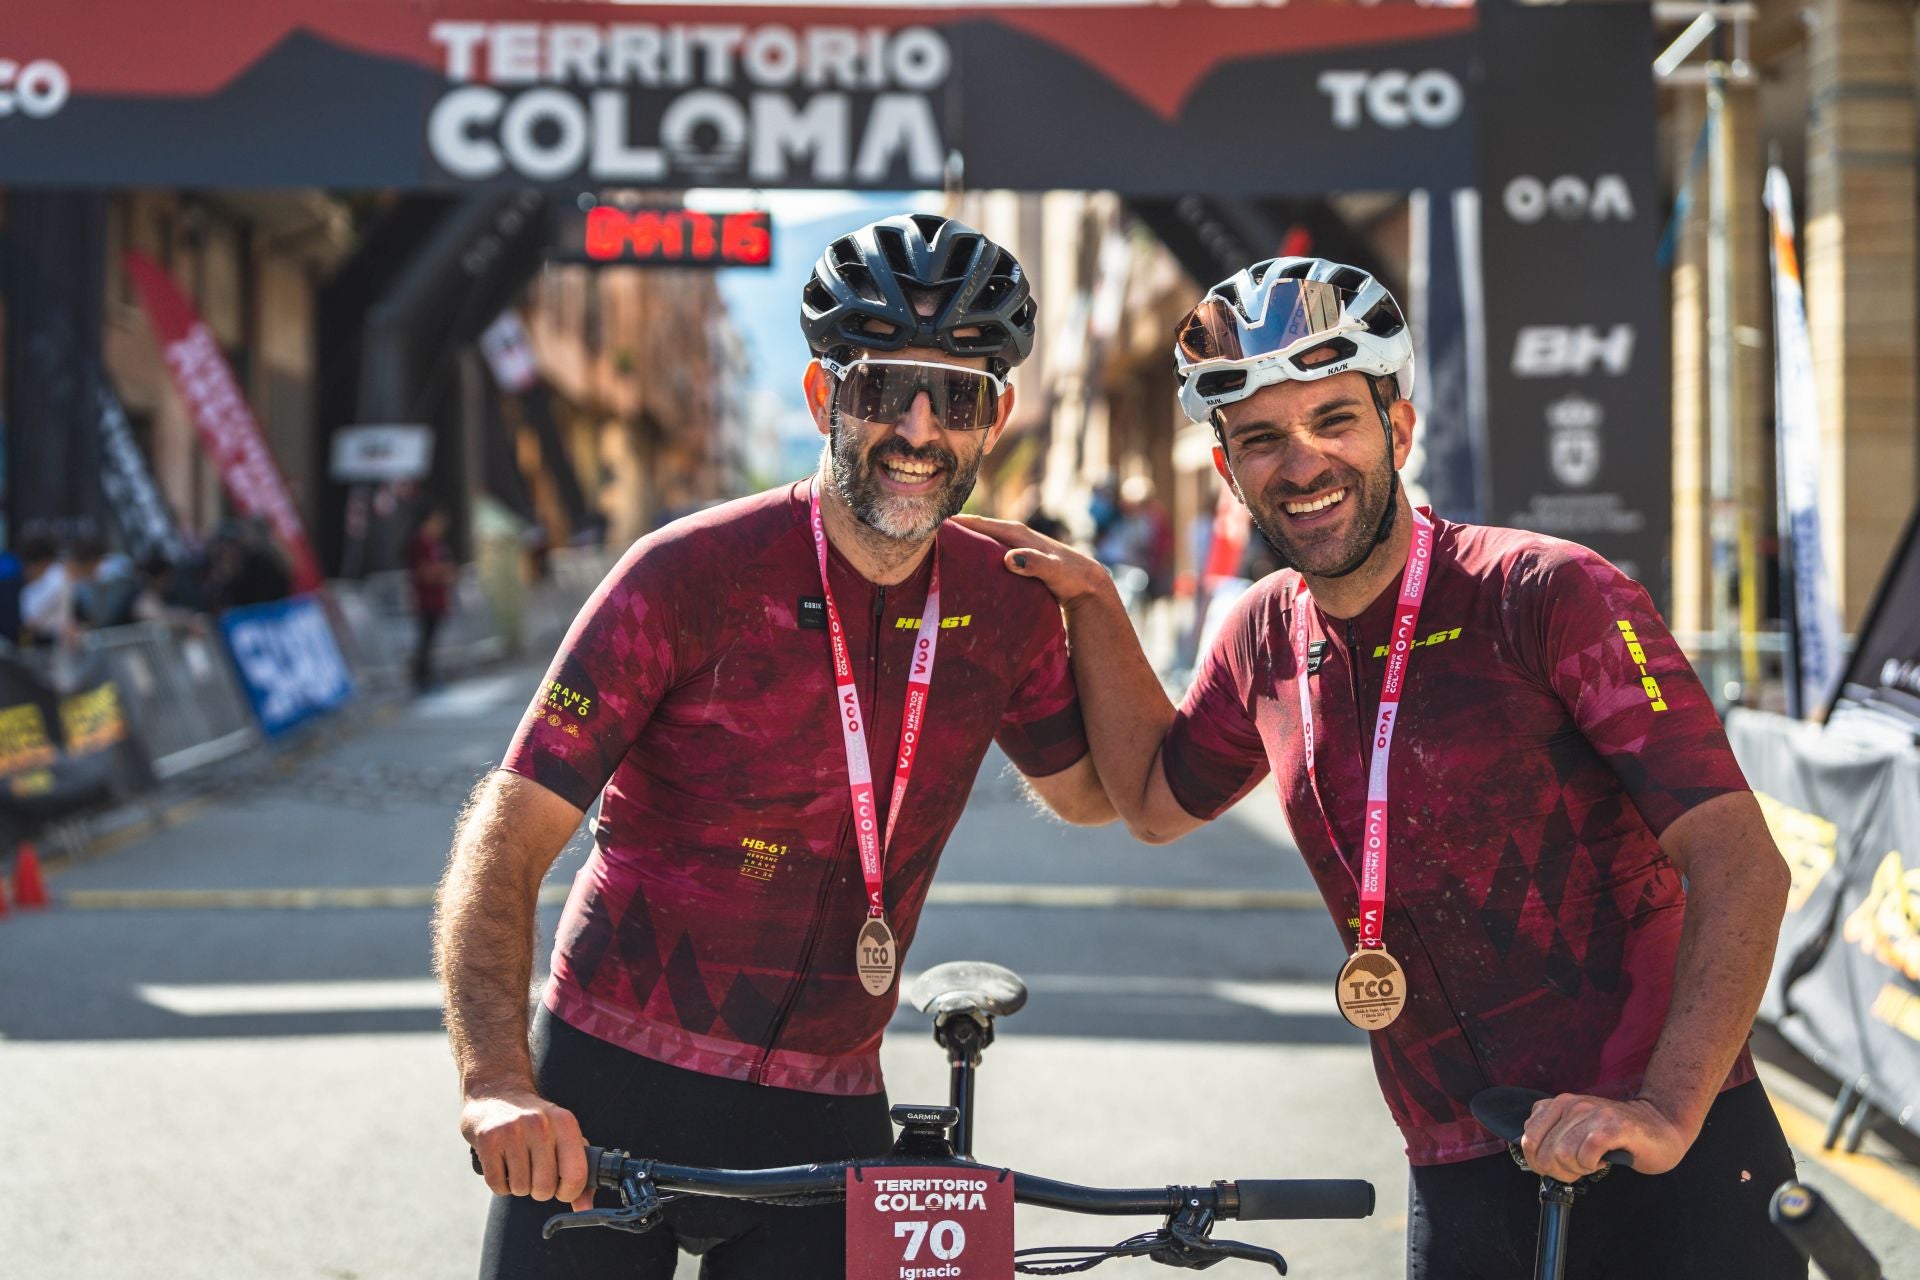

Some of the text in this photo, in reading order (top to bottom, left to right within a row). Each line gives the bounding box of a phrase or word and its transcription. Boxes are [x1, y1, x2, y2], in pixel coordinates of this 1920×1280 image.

[430, 22, 951, 90] TERRITORIO
[1317, 69, 1464, 129] TCO
[428, 86, 946, 182] COLOMA
[1511, 324, 1636, 377] BH
[1404, 558, 1418, 596] TERRITORIO
[1411, 559, 1425, 598] COLOMA
[1385, 653, 1396, 693] TERRITORIO
[1390, 654, 1403, 693] COLOMA
[1616, 620, 1668, 712] HB-61
[907, 690, 919, 729] COLOMA
[741, 837, 787, 855] HB-61
[866, 833, 877, 874] COLOMA
[1364, 851, 1372, 892] TERRITORIO
[1371, 851, 1379, 893] COLOMA
[863, 947, 888, 965] TCO
[1349, 979, 1394, 1000] TCO
[907, 1112, 940, 1121] GARMIN
[874, 1179, 988, 1192] TERRITORIO
[874, 1193, 987, 1212] COLOMA
[894, 1219, 966, 1261] 70
[900, 1263, 961, 1280] Ignacio
